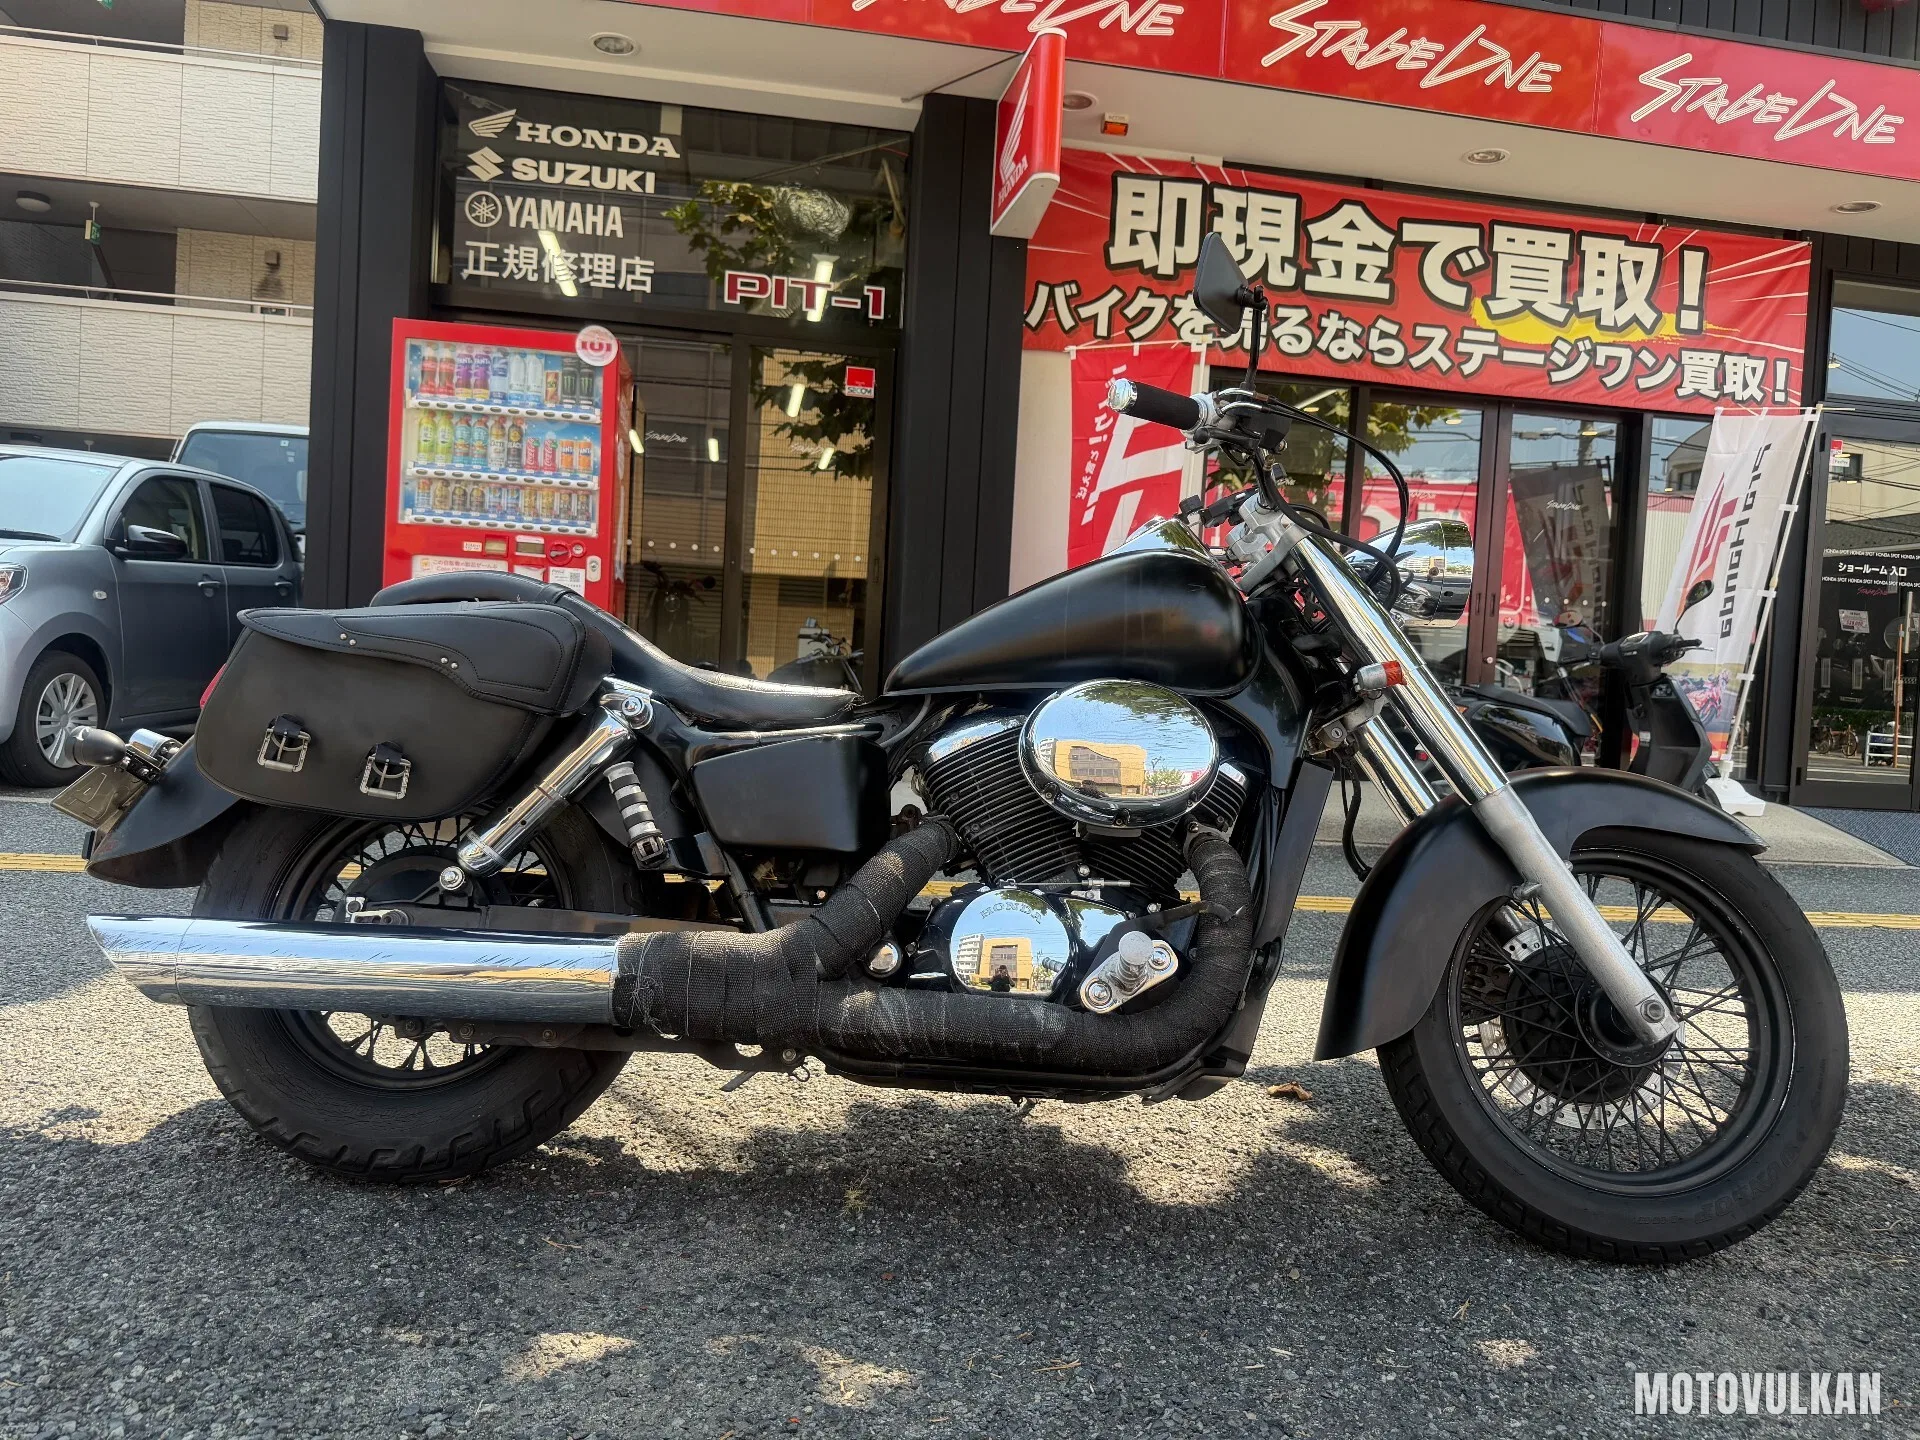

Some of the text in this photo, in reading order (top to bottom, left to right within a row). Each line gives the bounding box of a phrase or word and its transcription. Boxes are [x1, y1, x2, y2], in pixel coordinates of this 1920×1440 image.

[515, 120, 680, 159] HONDA
[511, 157, 656, 194] SUZUKI
[998, 154, 1029, 208] HONDA
[504, 195, 625, 239] YAMAHA
[462, 239, 656, 294] 正規修理店
[1106, 173, 1711, 334] 即現金で買取!
[723, 269, 887, 320] PIT-1
[980, 901, 1042, 925] HONDA
